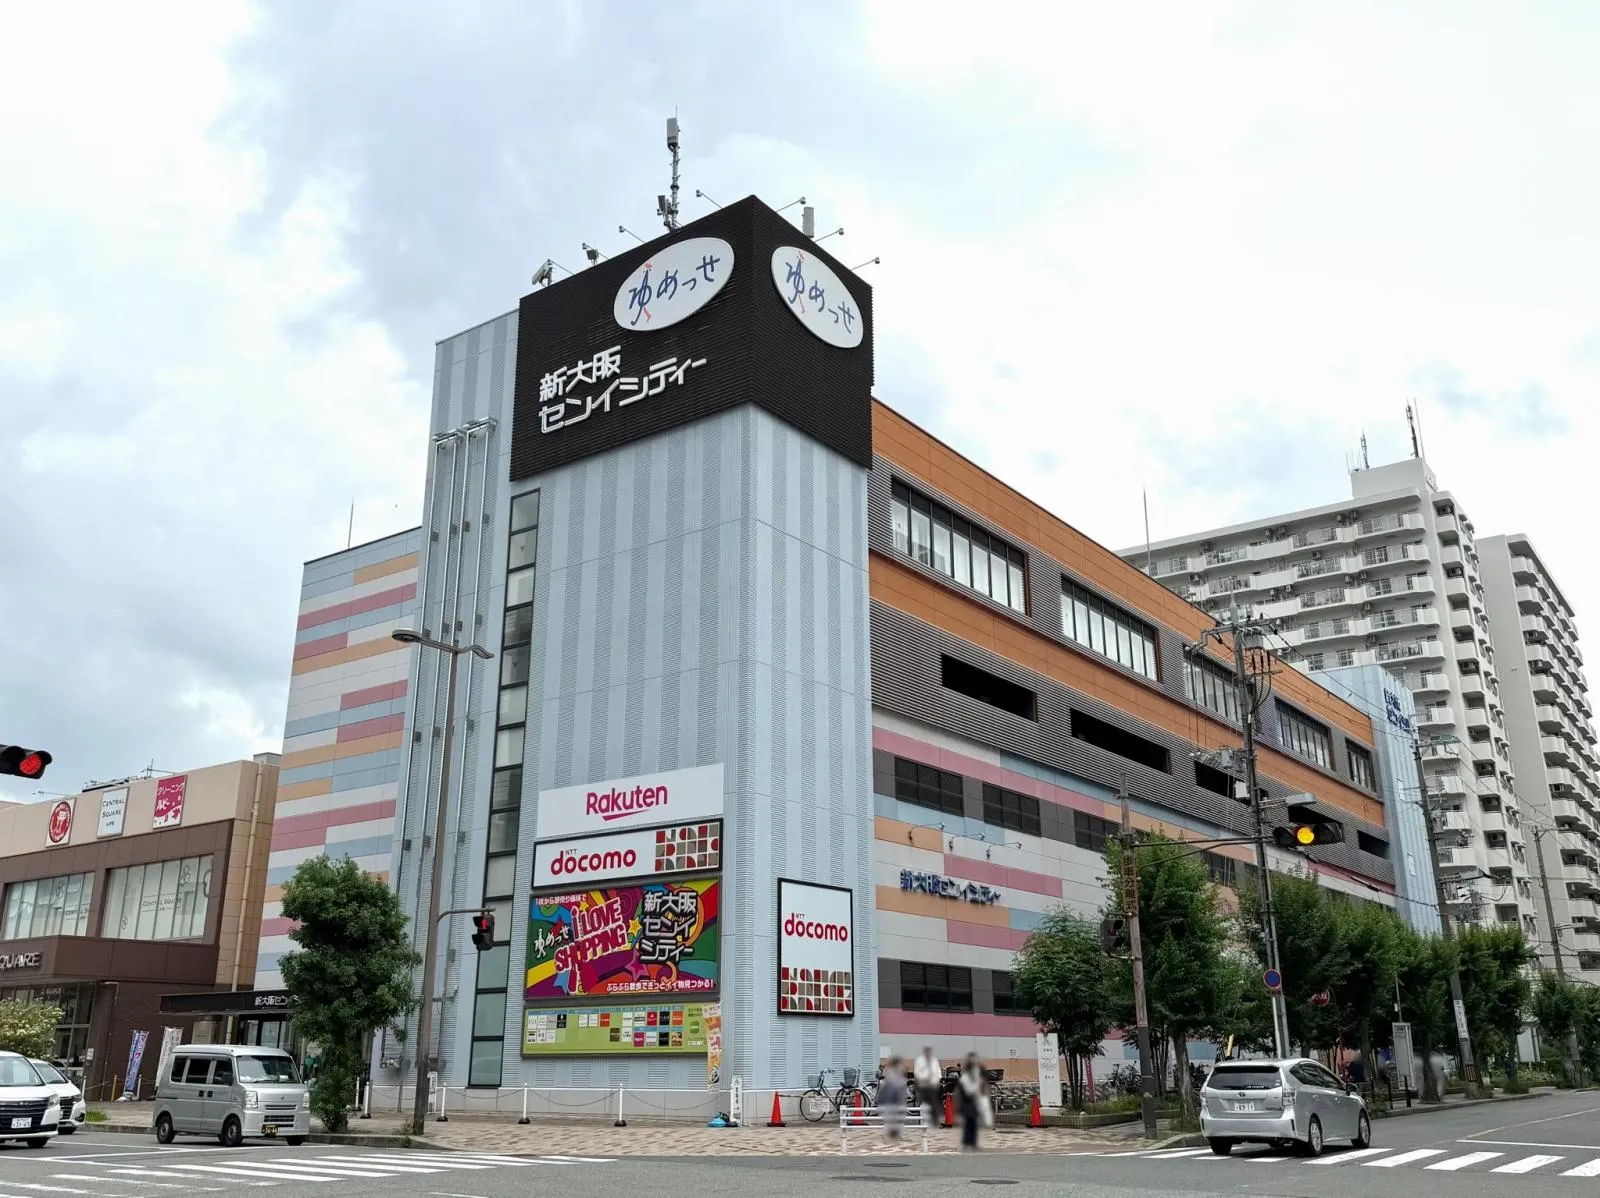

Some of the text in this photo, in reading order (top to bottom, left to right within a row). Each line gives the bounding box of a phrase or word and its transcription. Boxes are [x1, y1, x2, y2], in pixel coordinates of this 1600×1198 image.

[628, 254, 721, 326] ゆめっせ
[784, 257, 856, 335] ゆめっせ
[539, 344, 622, 402] 新大阪
[538, 356, 708, 434] センイシティー
[101, 808, 123, 818] SQUARE
[102, 799, 125, 808] CENTRAL
[585, 785, 669, 816] Rakuten
[550, 849, 638, 876] docomo
[565, 848, 578, 857] NTT
[899, 868, 1002, 905] 新大阪センイシティー
[580, 896, 624, 937] LOVE
[643, 891, 698, 913] 新大阪
[795, 912, 806, 920] NTT
[642, 914, 697, 938] センイ
[784, 912, 849, 942] docomo
[554, 922, 628, 974] SHOPPING
[639, 938, 695, 963] シティー
